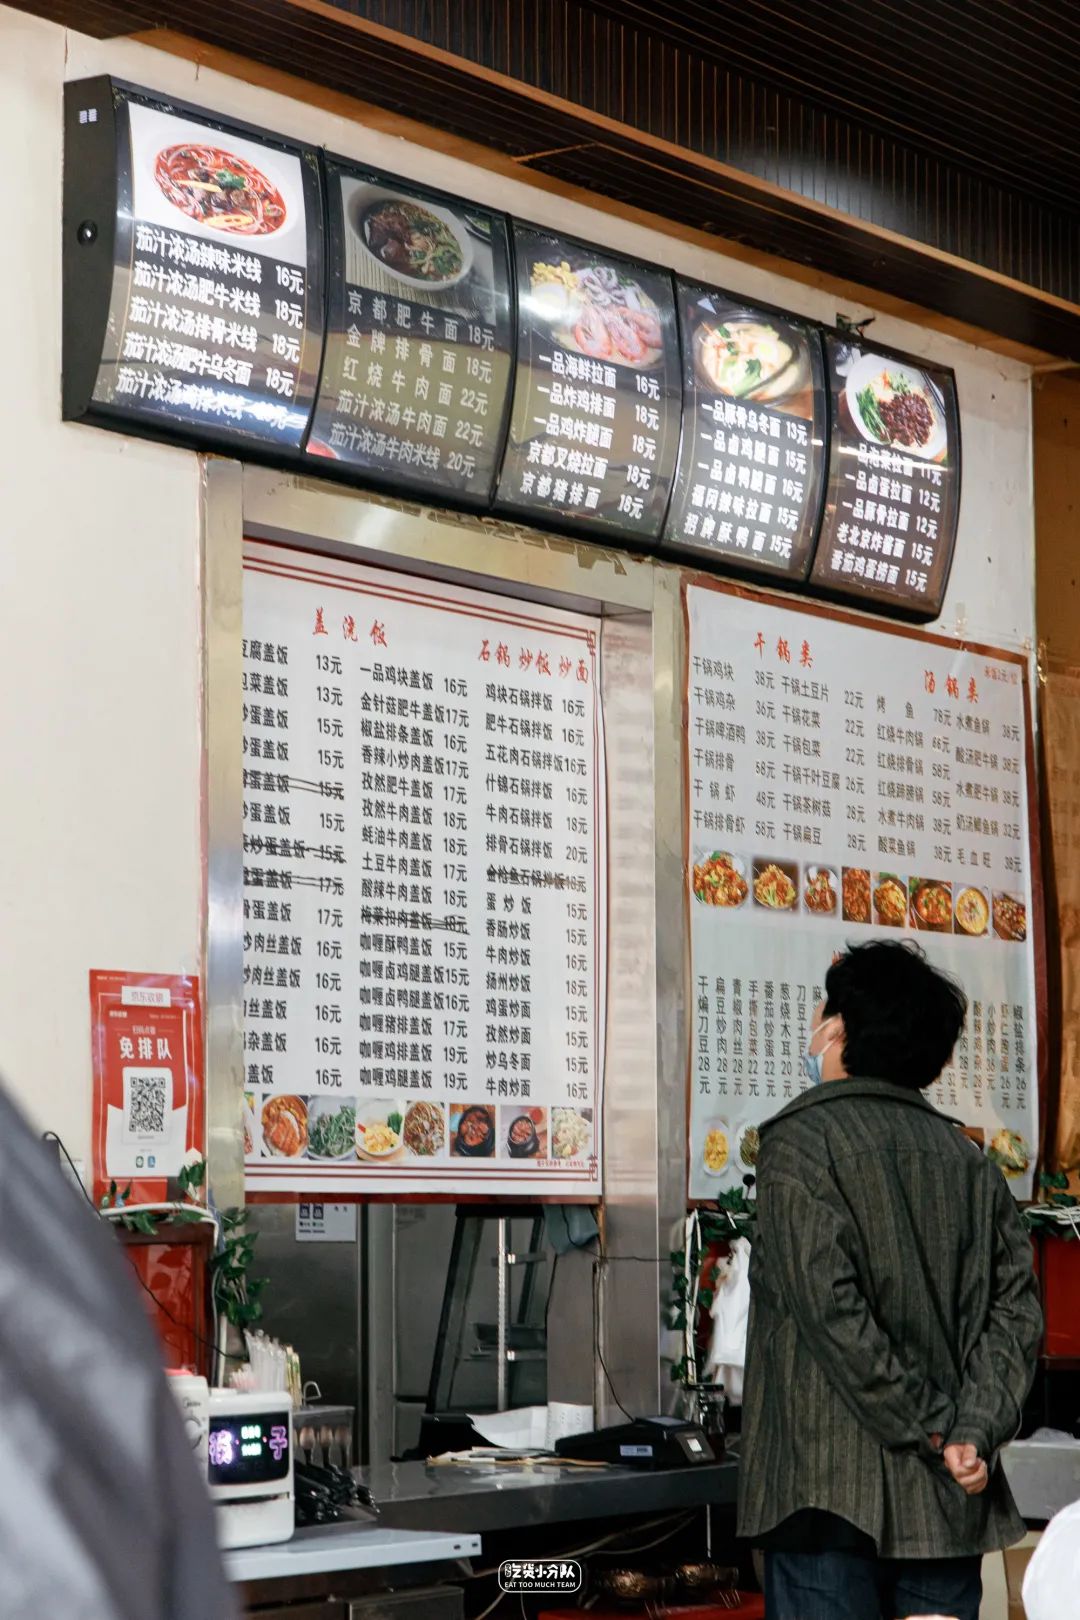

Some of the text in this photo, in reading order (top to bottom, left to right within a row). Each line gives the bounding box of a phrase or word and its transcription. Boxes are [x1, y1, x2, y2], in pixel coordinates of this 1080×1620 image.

[137, 226, 304, 295] 茄汁浓汤辣味米线 16元
[134, 261, 303, 329] 茄汁浓汤肥牛米线 18元
[130, 297, 300, 362] 茄汁浓汤排骨米线 18元
[347, 290, 494, 352] 京都肥牛面 18元
[124, 332, 252, 386] 茄汁浓汤肥牛乌冬面
[266, 368, 294, 397] 18元
[346, 324, 492, 384] 金牌排骨面 18元
[343, 357, 453, 406] 红烧牛肉面
[462, 388, 488, 416] 22元
[539, 351, 660, 400] 一品海鲜拉面 16元
[336, 389, 448, 437] 茄汁浓汤牛肉面
[455, 419, 484, 447] 22元
[537, 382, 660, 430] 一品炸鸡排面 18元
[786, 421, 808, 446] 13元
[329, 422, 476, 479] 茄汁浓汤牛肉米线 20元
[632, 435, 657, 460] 18元
[527, 440, 651, 490] 京都叉烧拉面 18元
[785, 450, 807, 475] 15元
[618, 494, 644, 519] 18元
[919, 489, 940, 513] 12元
[778, 507, 799, 531] 15元
[916, 516, 938, 539] 12元
[770, 534, 792, 558] 15元
[837, 522, 933, 566] 老北京炸酱面 15元
[905, 569, 928, 592] 15元
[316, 655, 342, 675] 13元
[693, 655, 775, 690] 干锅鸡块 38元
[360, 663, 467, 697] 一品鸡块盖饭 16元
[781, 675, 864, 709] 干锅土豆片 22元
[316, 686, 343, 706] 13元
[486, 683, 585, 717] 鸡块石锅拌饭 16元
[694, 686, 776, 720] 干锅鸡杂 36元
[317, 718, 344, 738] 15元
[486, 713, 584, 747] 肥牛石锅拌饭 16元
[694, 716, 775, 749] 干锅啤酒鸭 38元
[782, 704, 864, 738] 干锅花菜 22元
[361, 718, 467, 753] 椒盐排条盖饭 16元
[877, 723, 924, 748] 红烧牛肉锅
[318, 750, 344, 769] 15元
[694, 747, 776, 780] 干锅排骨 58元
[783, 734, 865, 766] 干锅包菜 22元
[362, 772, 467, 805] 孜然肥牛盖饭 17元
[486, 773, 587, 805] 什锦石锅拌饭 16元
[693, 778, 776, 809] 干锅虾 48元
[846, 776, 865, 795] 26元
[362, 798, 467, 831] 孜然牛肉盖饭 18元
[486, 803, 588, 835] 牛肉石锅拌饭 18元
[783, 793, 831, 818] 干锅茶树菇
[320, 813, 345, 832] 15元
[693, 809, 776, 839] 干锅排骨虾 58元
[783, 823, 822, 846] 干锅扁豆
[362, 825, 467, 856] 蚝油牛肉盖饭 18元
[486, 833, 588, 864] 排骨石锅拌饭 20元
[362, 851, 467, 882] 土豆牛肉盖饭 17元
[362, 878, 467, 908] 酸辣牛肉盖饭 18元
[487, 892, 587, 921] 蛋炒饭 15元
[318, 909, 343, 928] 17元
[486, 919, 587, 946] 香肠炒饭 15元
[317, 941, 342, 959] 16元
[444, 942, 467, 960] 15元
[486, 945, 587, 972] 牛肉炒饭 16元
[316, 973, 341, 991] 16元
[486, 972, 587, 997] 扬州炒饭 18元
[316, 1005, 341, 1023] 16元
[486, 998, 588, 1022] 鸡蛋炒面 15元
[444, 1020, 468, 1038] 17元
[486, 1024, 588, 1048] 孜然炒面 15元
[119, 1037, 172, 1060] 免排队
[315, 1037, 342, 1055] 16元
[444, 1046, 468, 1064] 19元
[486, 1050, 588, 1074] 炒乌冬面 15元
[316, 1069, 342, 1087] 16元
[444, 1072, 468, 1090] 19元
[486, 1077, 588, 1099] 牛肉炒面 16元
